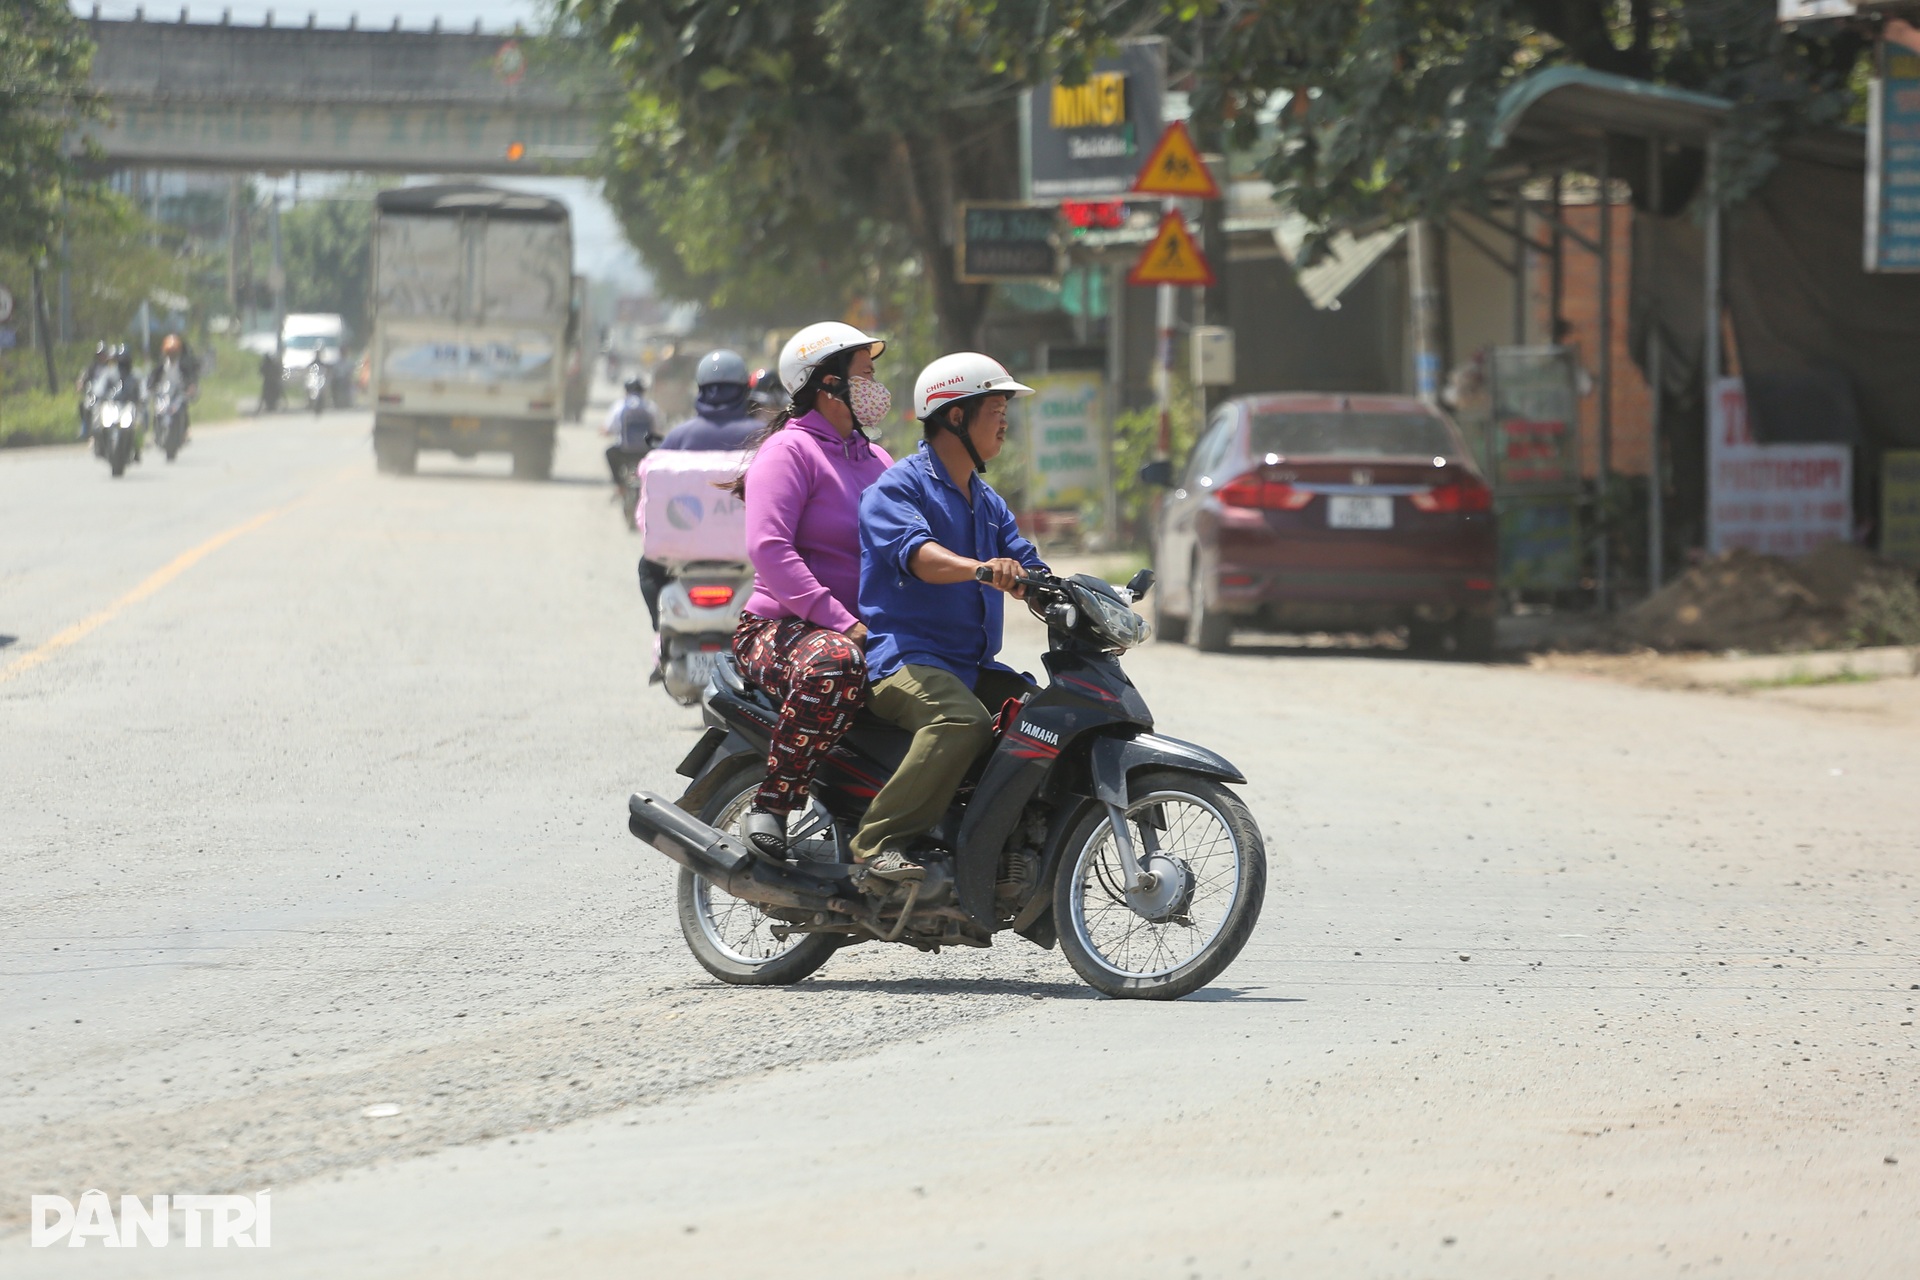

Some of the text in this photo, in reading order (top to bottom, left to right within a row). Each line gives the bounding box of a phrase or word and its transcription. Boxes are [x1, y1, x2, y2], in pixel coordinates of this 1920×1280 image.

[926, 375, 965, 394] CHÍN HẢI
[1019, 720, 1060, 746] YAMAHA
